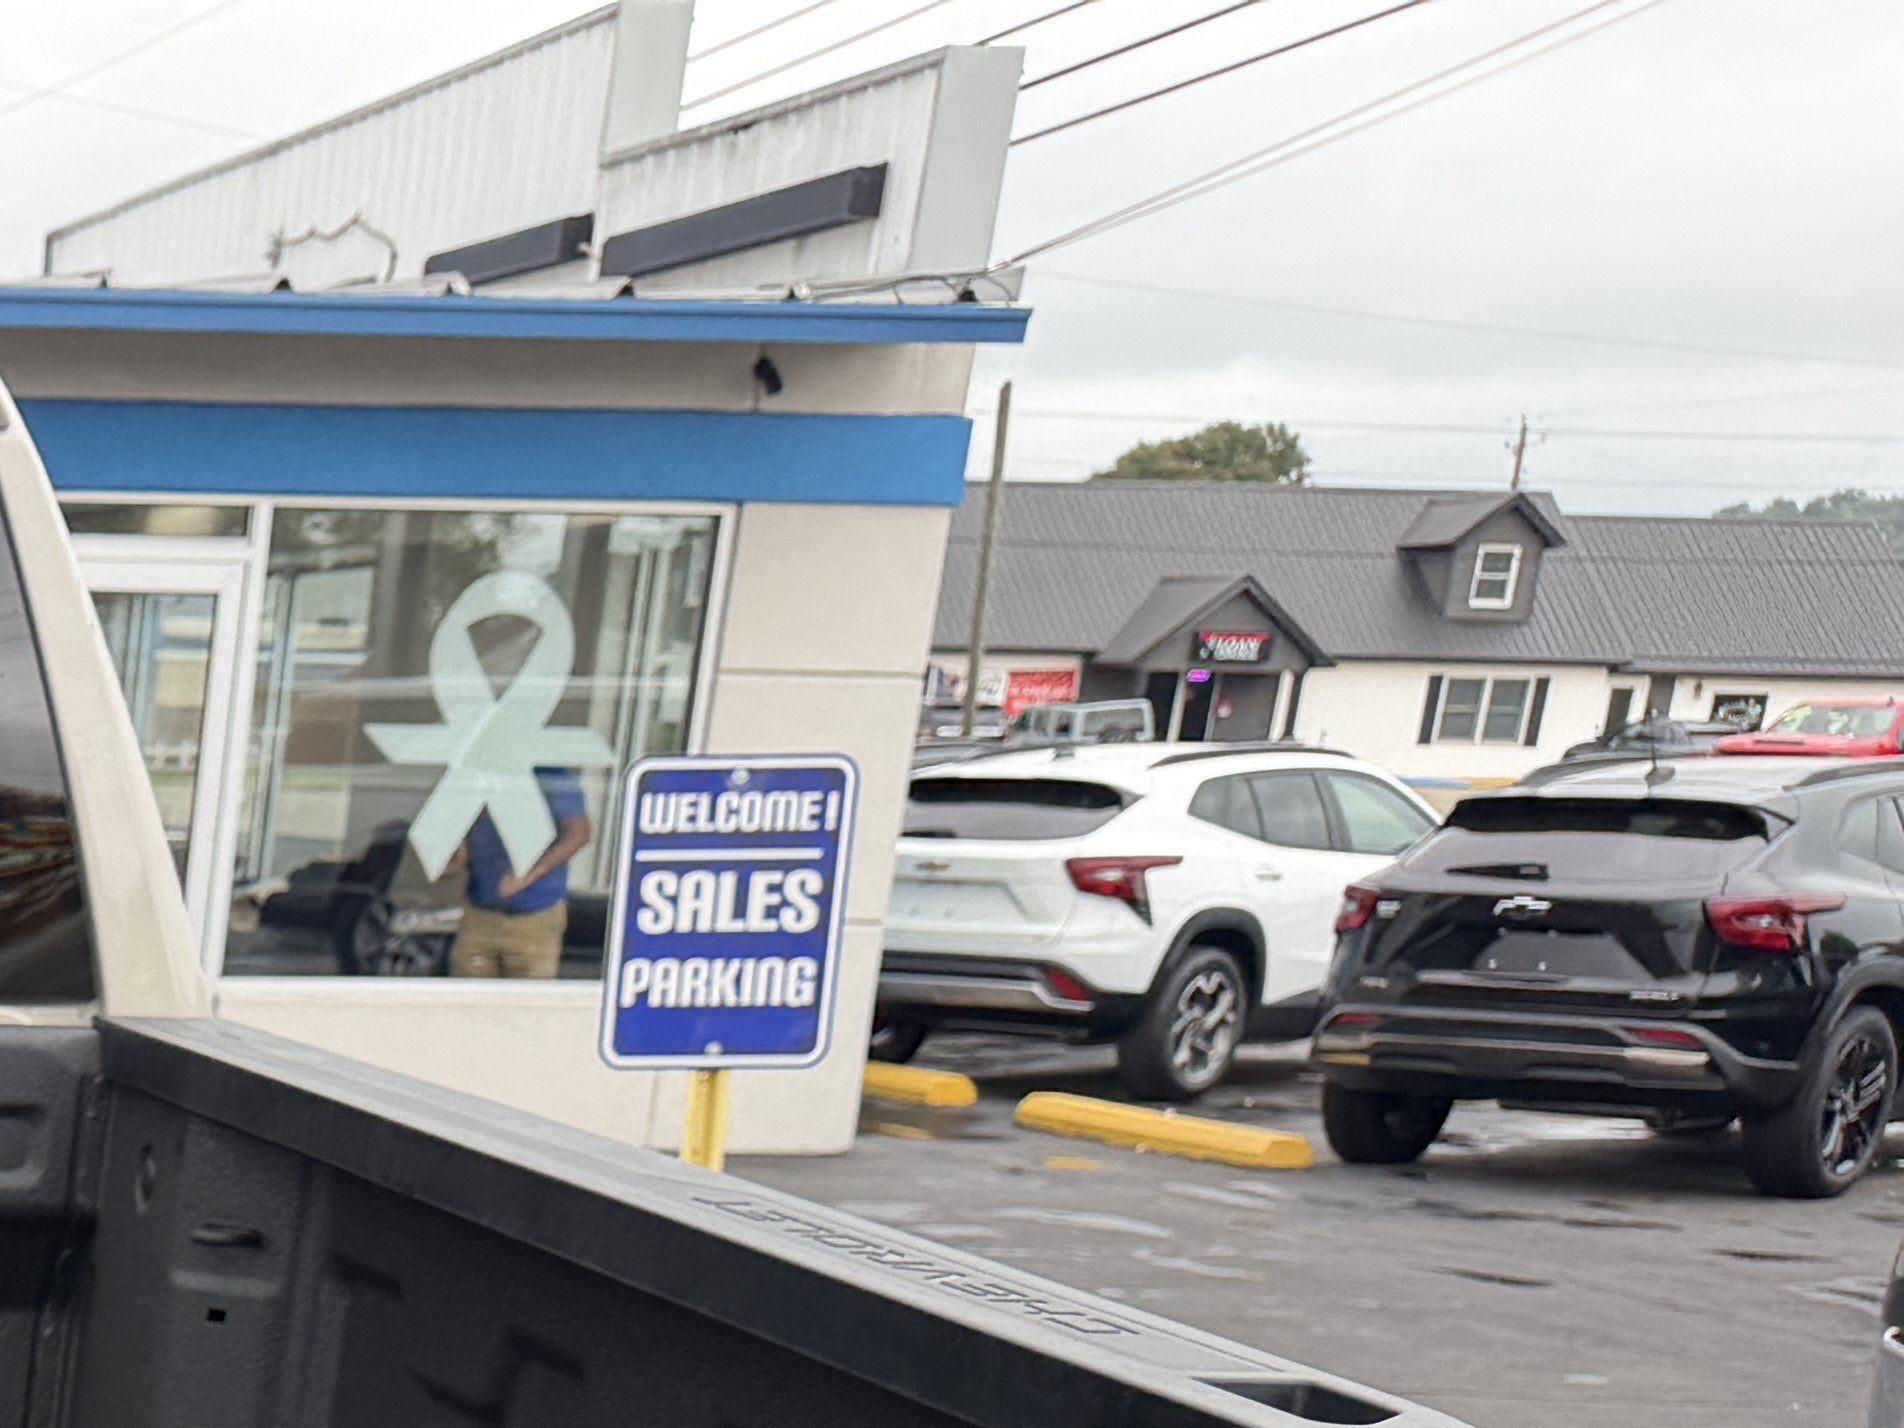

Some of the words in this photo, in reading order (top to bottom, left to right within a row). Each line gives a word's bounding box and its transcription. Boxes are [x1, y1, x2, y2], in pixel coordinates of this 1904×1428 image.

[640, 791, 841, 834] WELCOME!
[637, 869, 824, 934] SALES
[620, 957, 819, 1008] PARKING
[692, 1196, 1141, 1335] CHEVROLET
